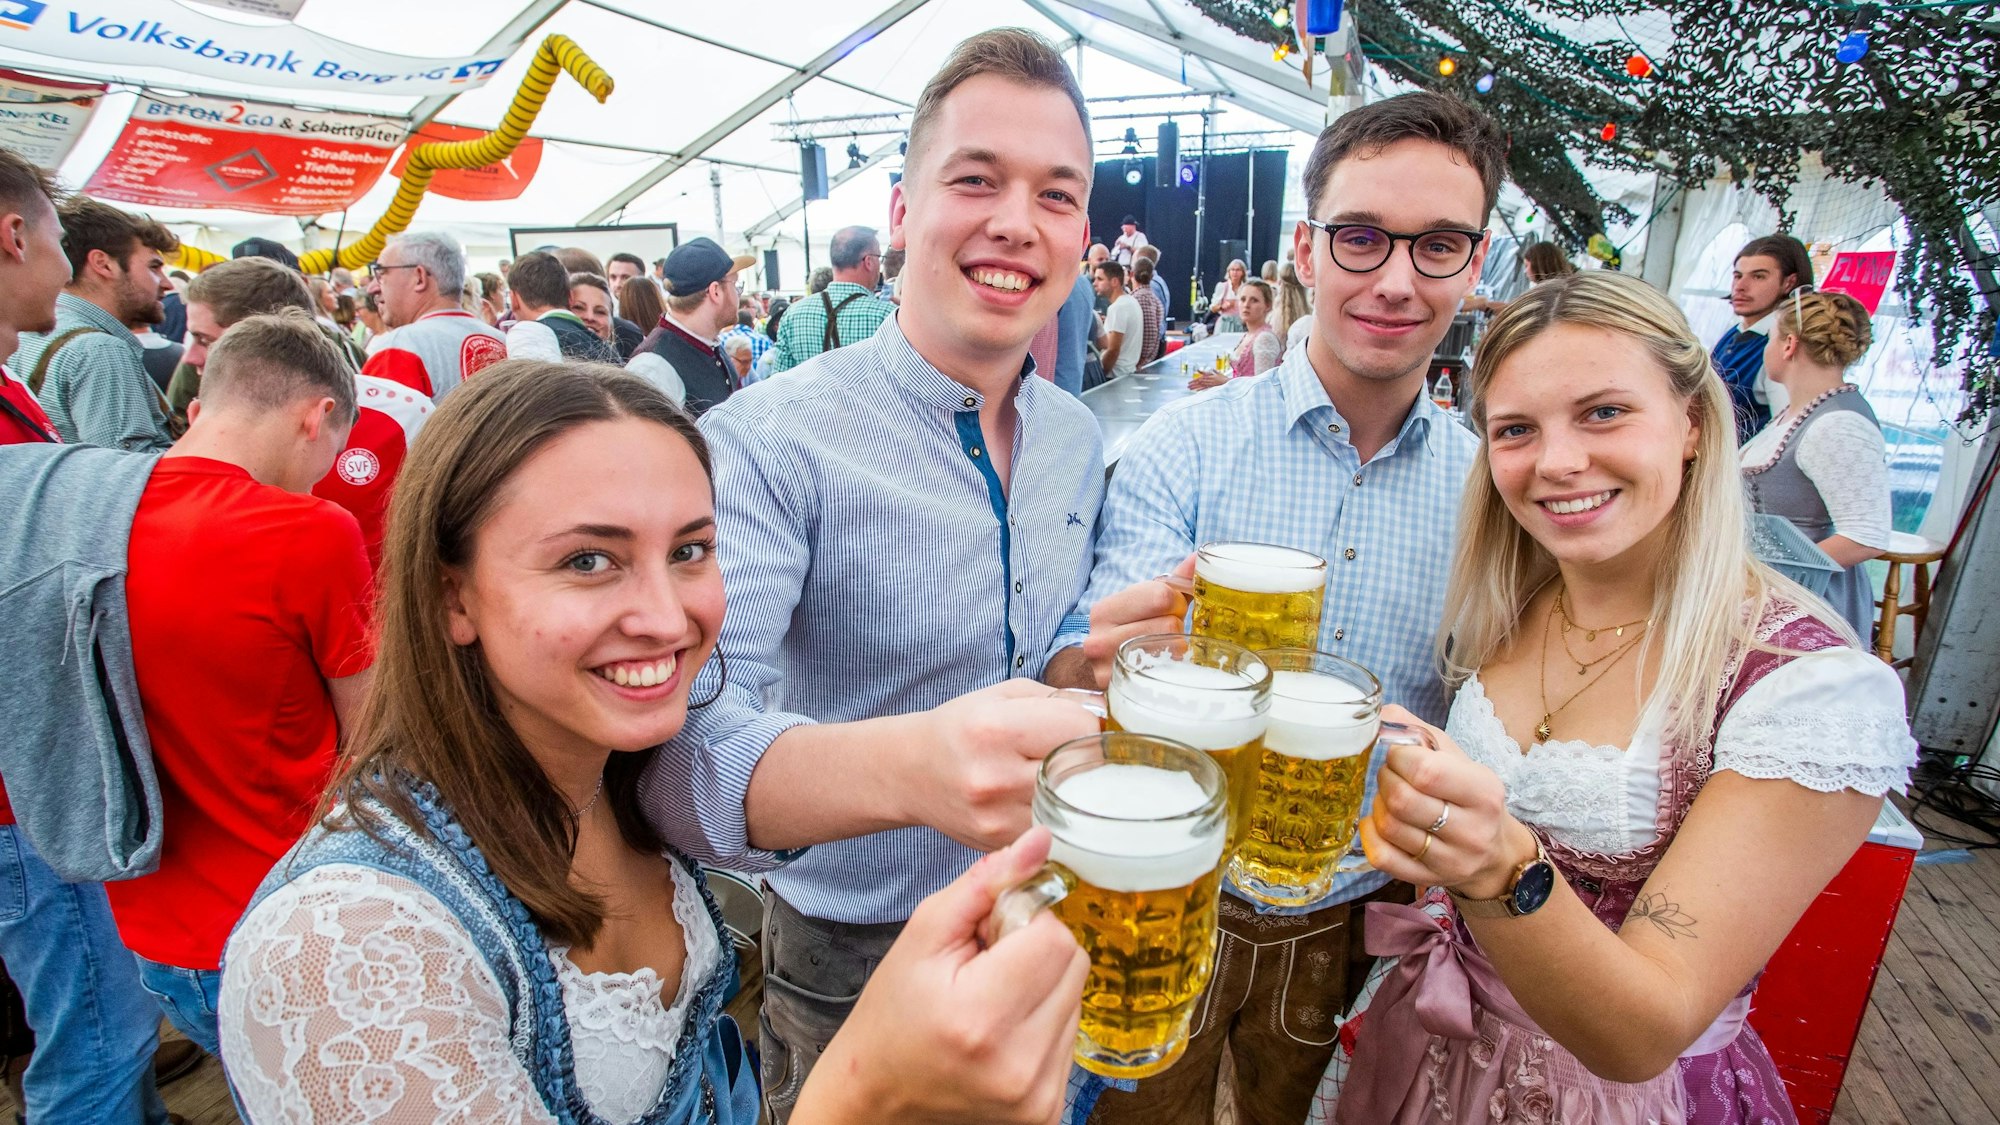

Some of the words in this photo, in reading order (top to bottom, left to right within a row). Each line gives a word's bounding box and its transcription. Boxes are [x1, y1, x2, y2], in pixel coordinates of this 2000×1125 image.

[68, 11, 303, 77] Volksbank
[279, 117, 294, 129] &
[300, 119, 400, 142] Schüttgüter
[310, 147, 388, 164] Straßenbau
[304, 161, 356, 175] Tiefbau
[296, 175, 354, 187] Abbruch
[1828, 254, 1894, 287] FLYING
[348, 460, 369, 473] SVF
